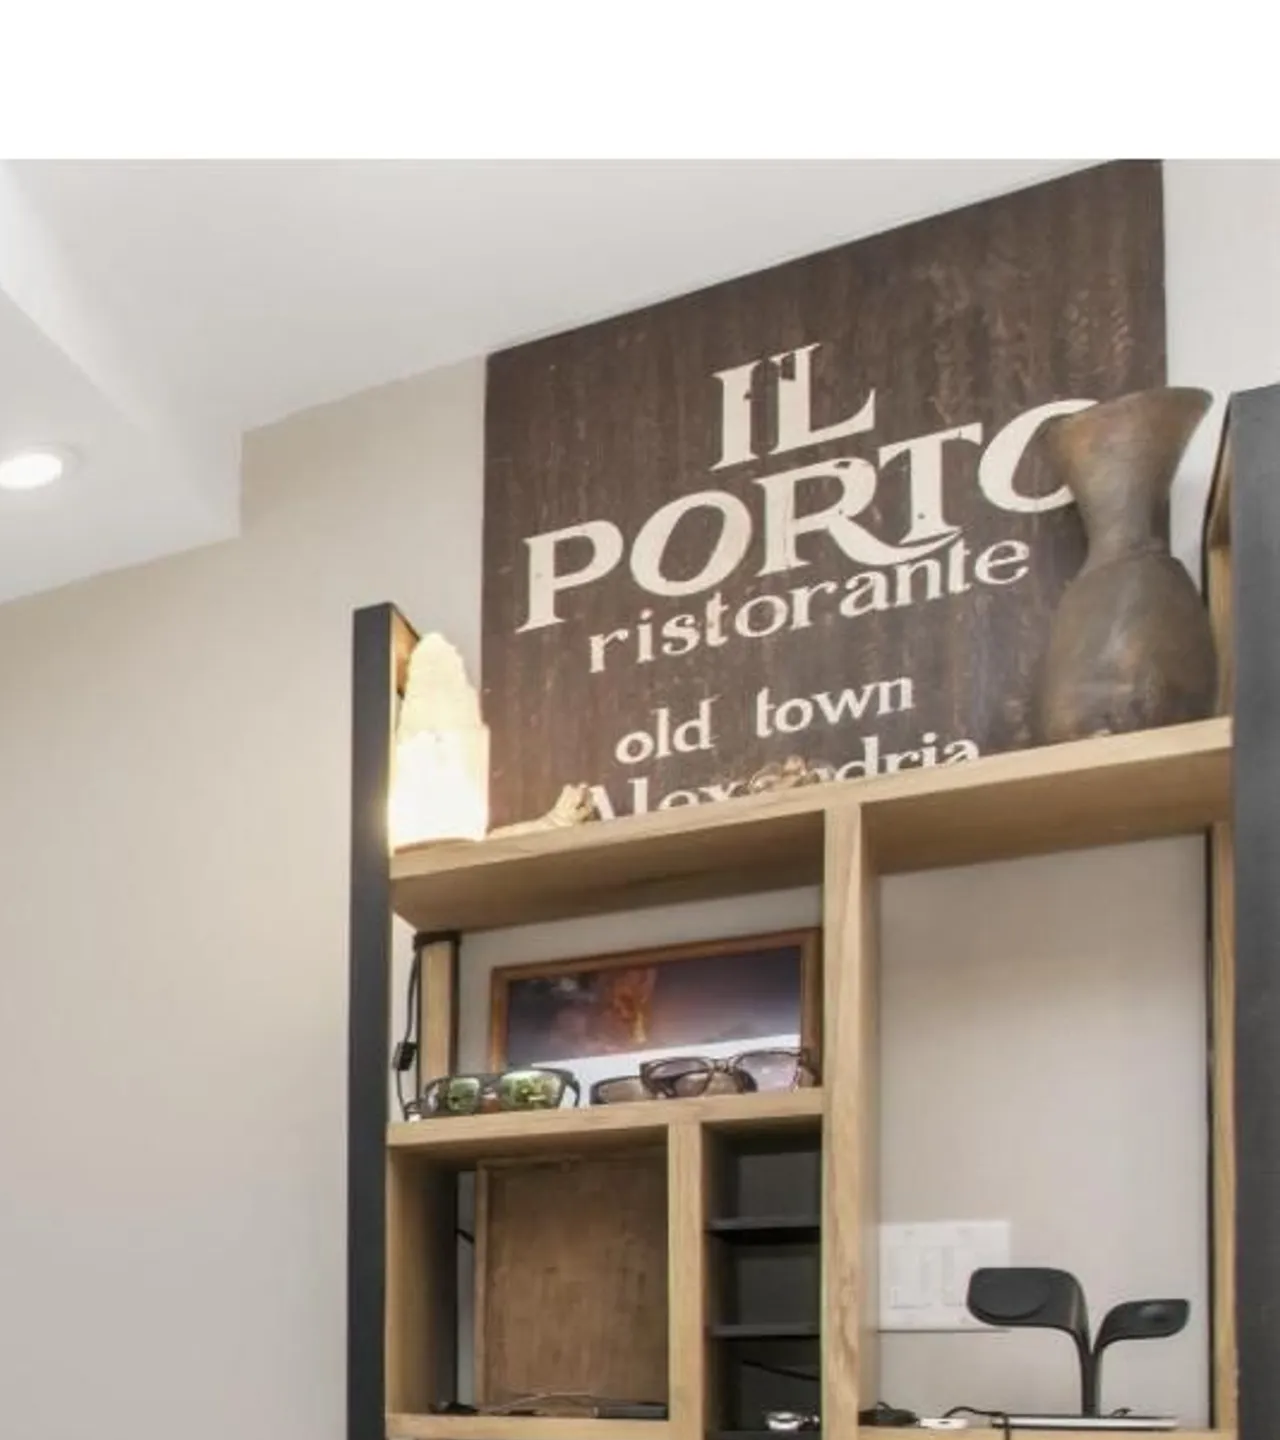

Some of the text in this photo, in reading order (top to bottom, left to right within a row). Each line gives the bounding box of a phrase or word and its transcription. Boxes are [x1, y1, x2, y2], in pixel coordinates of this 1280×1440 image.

[709, 343, 877, 472] IL
[588, 538, 1031, 674] ristorante
[615, 675, 915, 765] old town
[590, 731, 981, 821] lexdria
